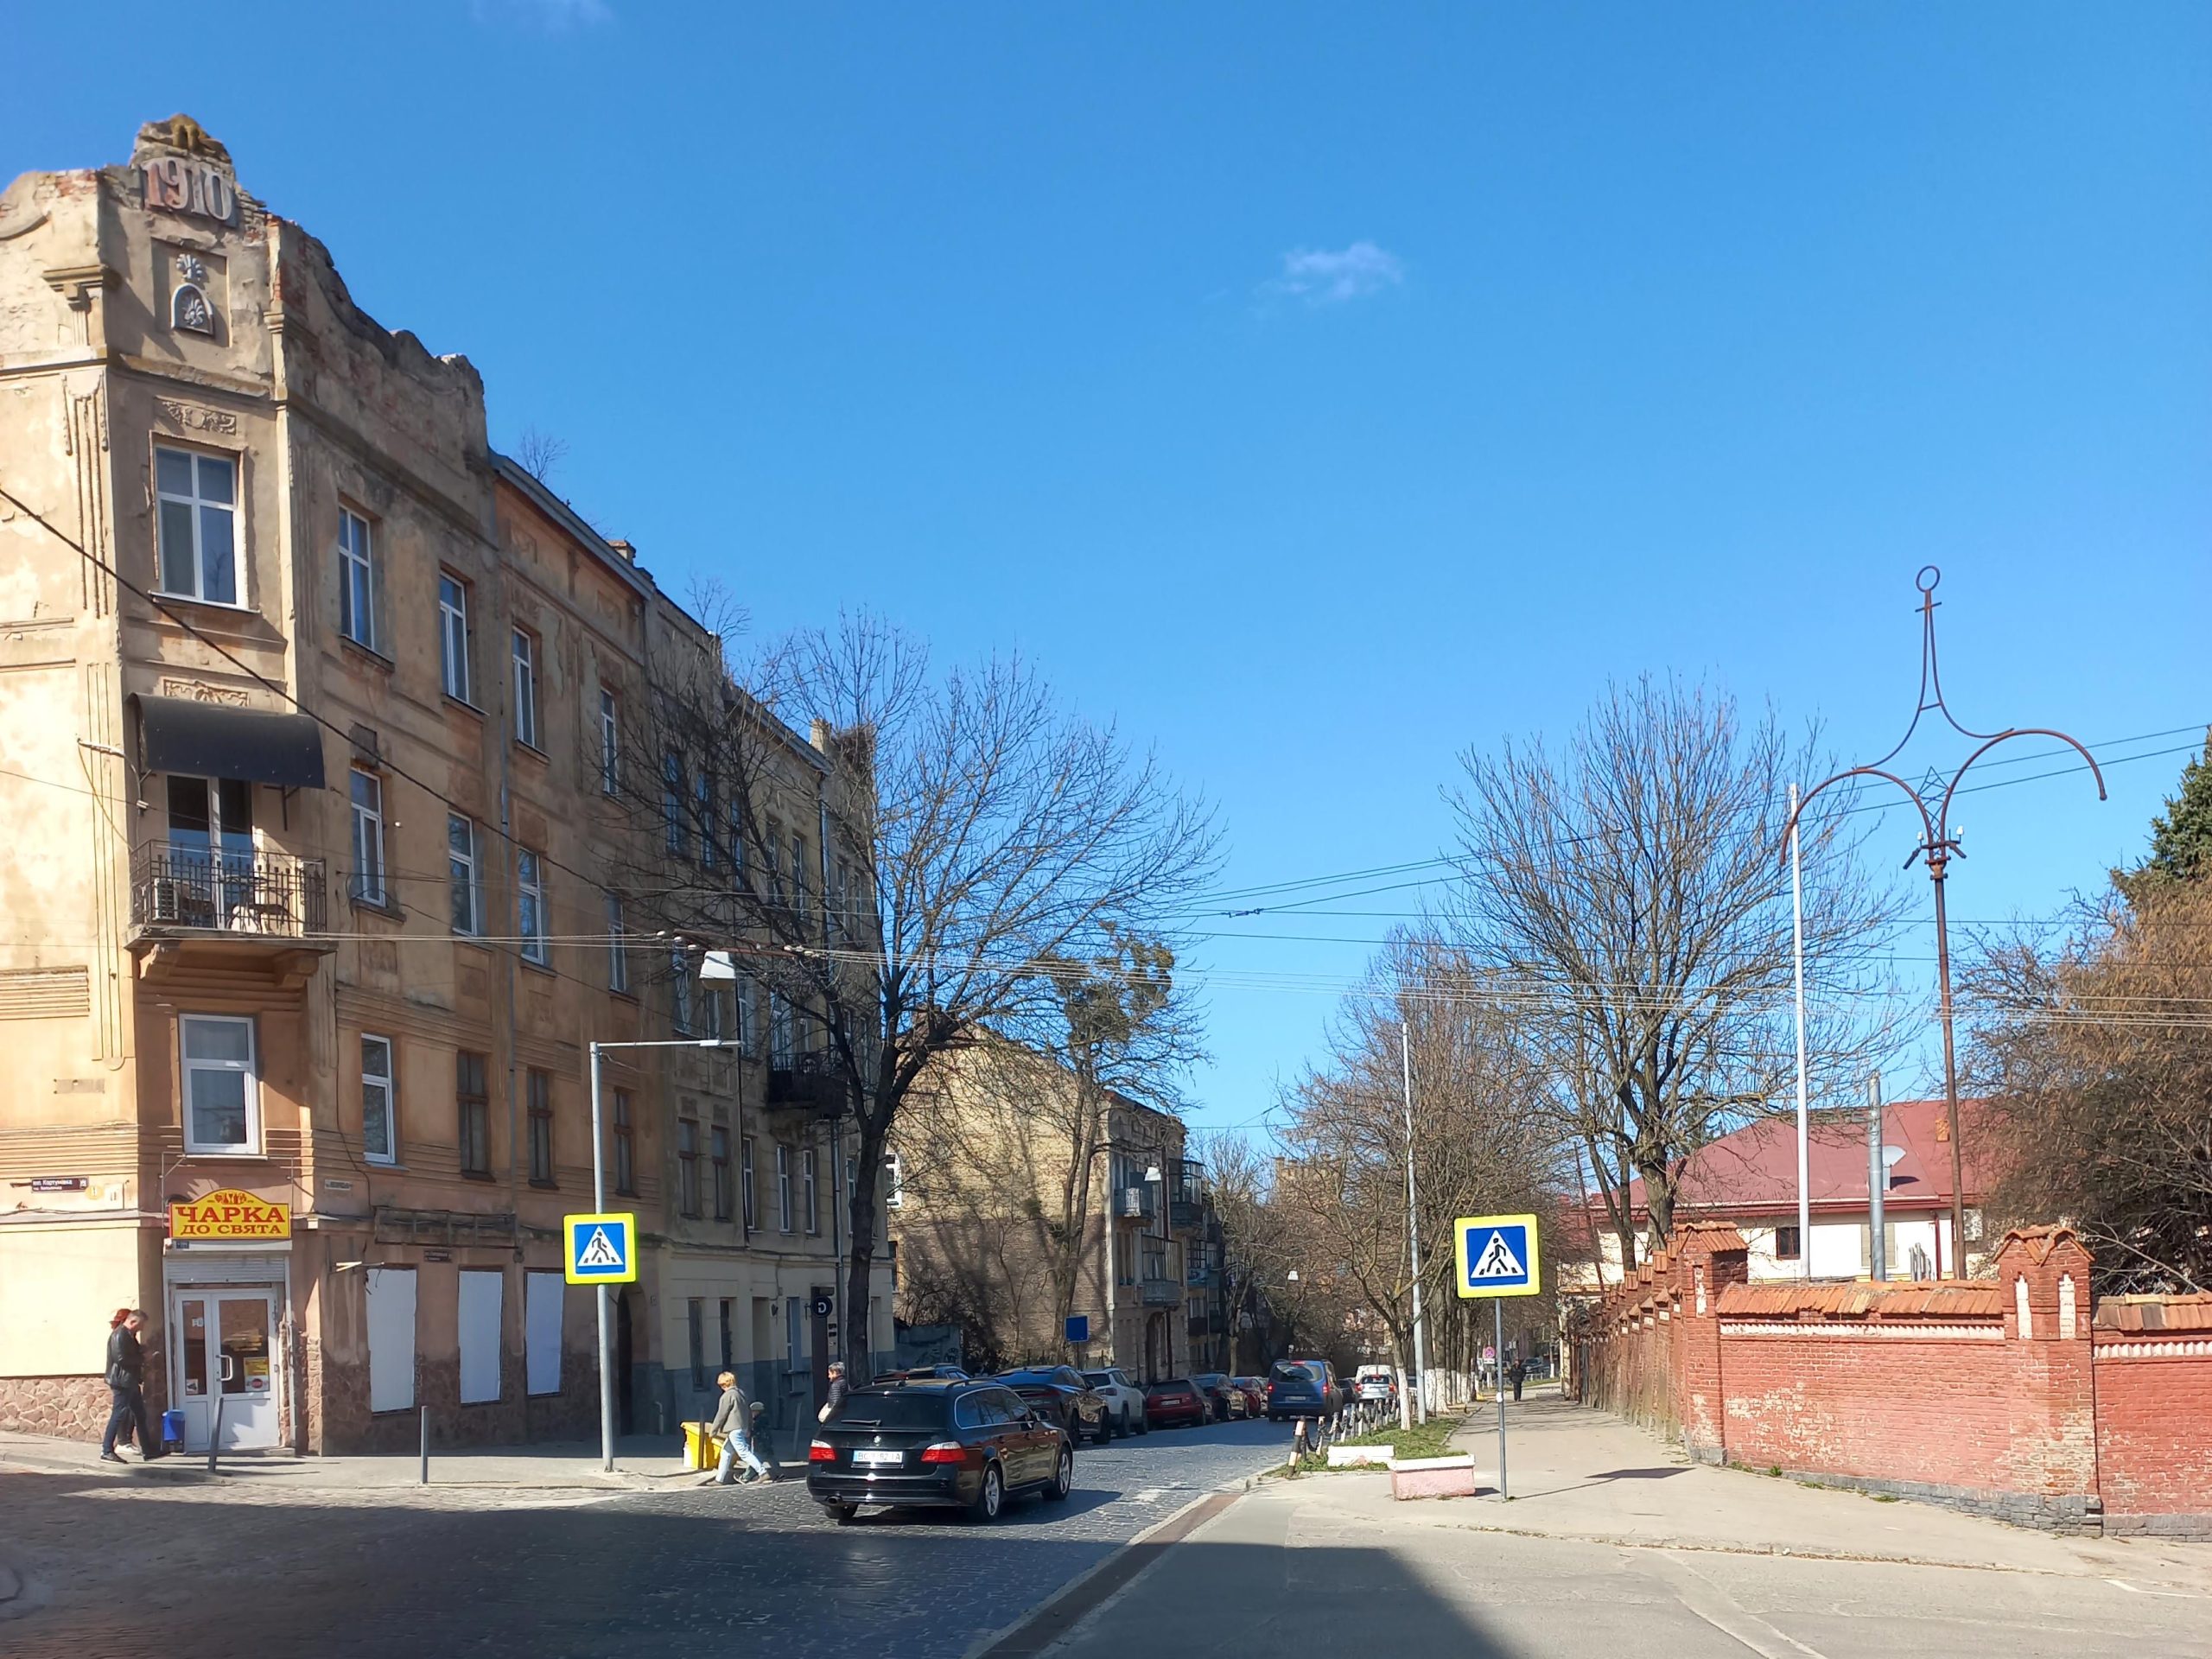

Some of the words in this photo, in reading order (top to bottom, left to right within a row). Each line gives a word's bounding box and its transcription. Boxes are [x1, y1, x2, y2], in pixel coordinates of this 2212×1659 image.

[141, 157, 233, 220] 1910
[175, 1206, 285, 1222] ЧАРКА
[181, 1224, 211, 1235] ДО
[217, 1224, 282, 1234] СВЯТА
